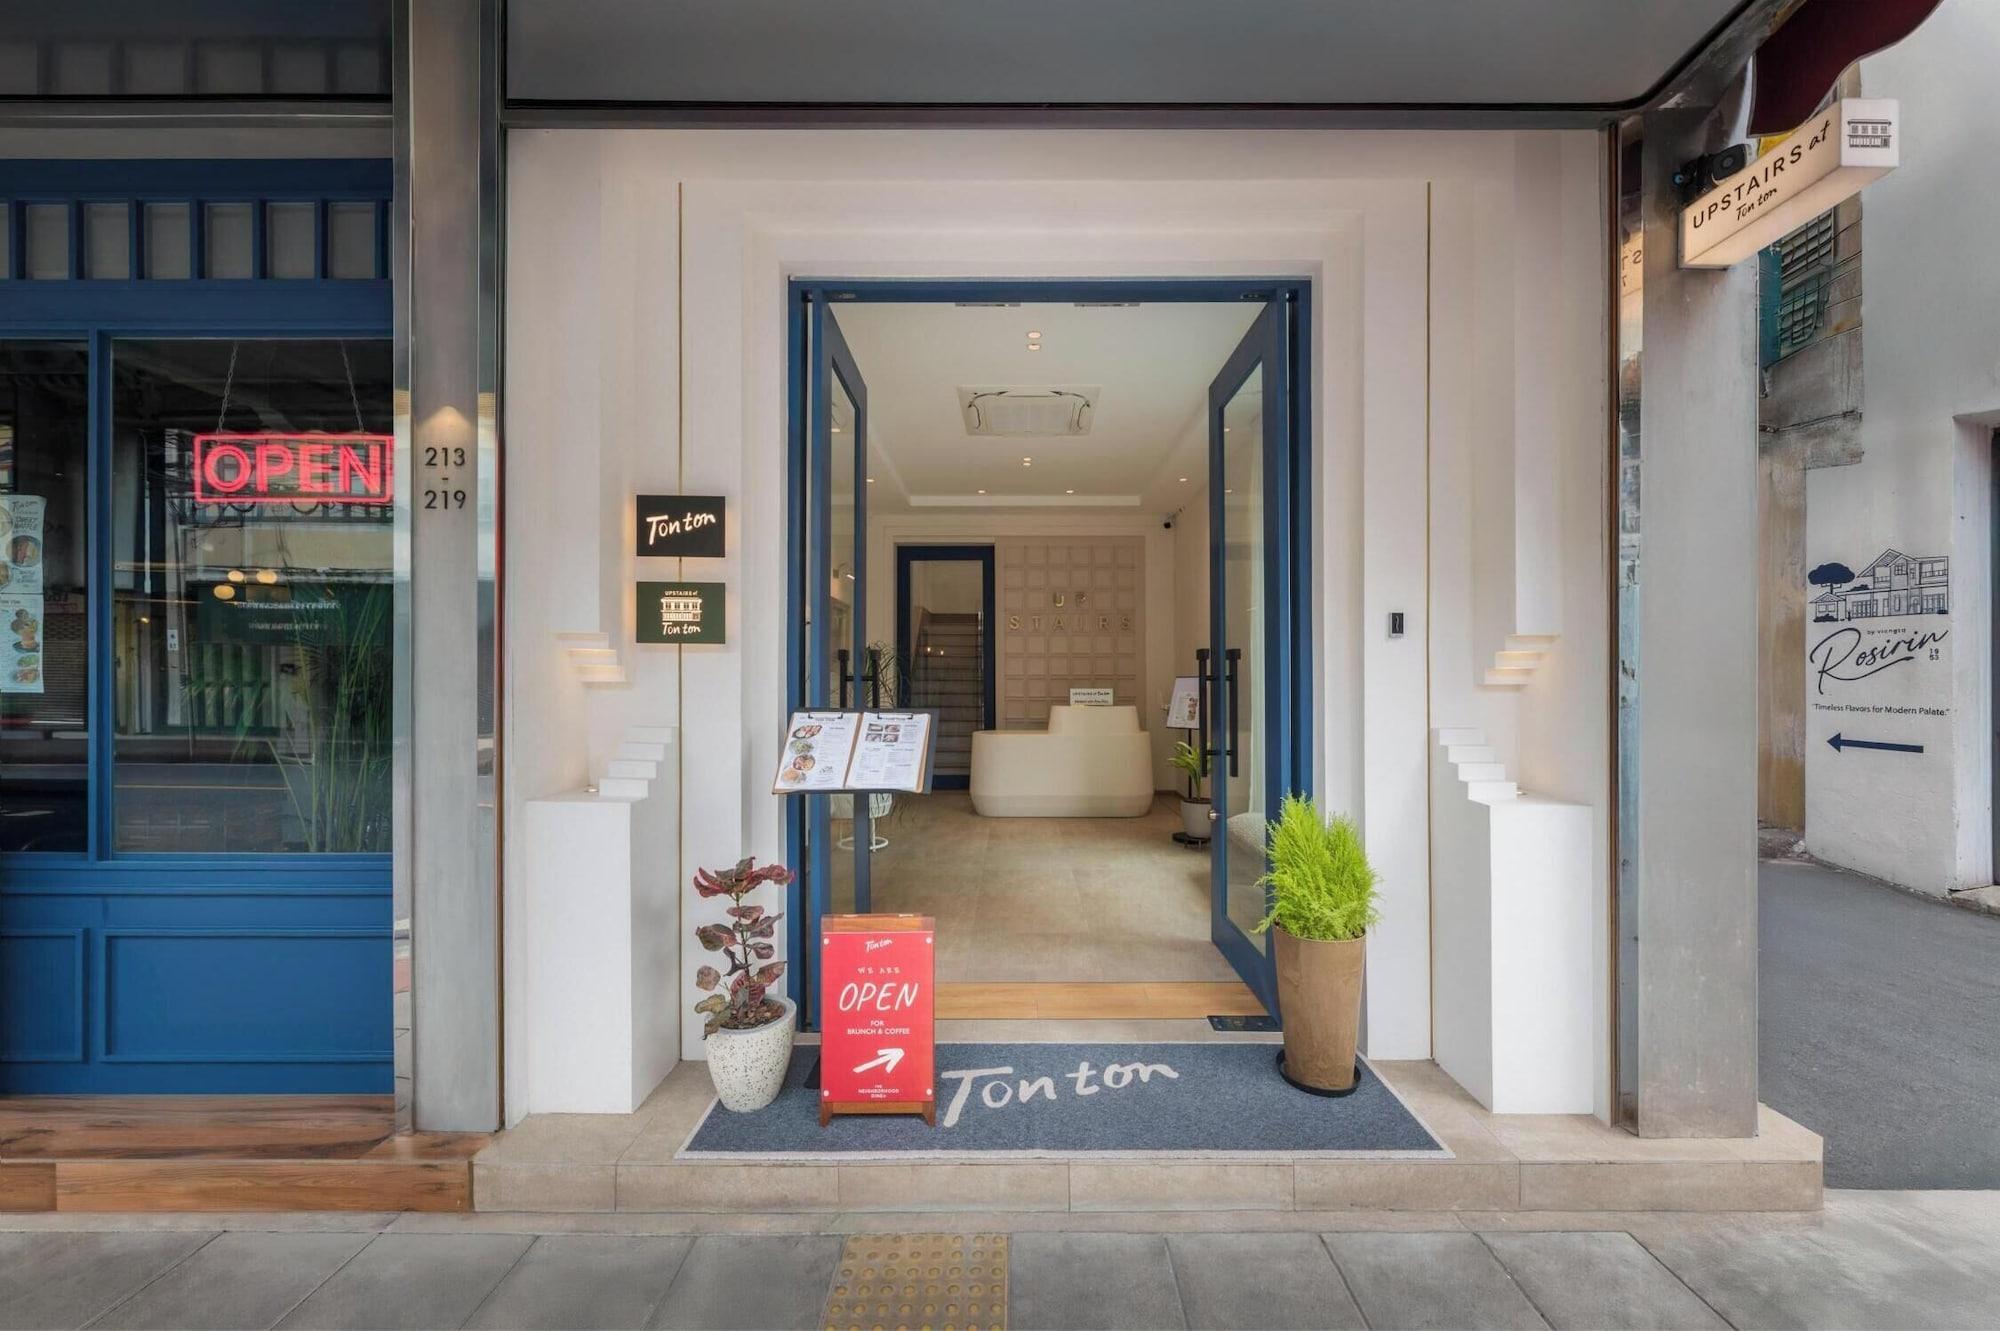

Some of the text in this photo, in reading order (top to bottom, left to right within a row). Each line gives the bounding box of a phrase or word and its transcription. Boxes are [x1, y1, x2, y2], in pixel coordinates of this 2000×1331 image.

[1693, 120, 1831, 229] UPSTAIRS at
[424, 448, 466, 467] 213
[204, 444, 381, 493] OPEN
[424, 490, 466, 509] 219
[1053, 591, 1087, 607] UP
[1009, 615, 1130, 631] STAIRS
[1810, 627, 1948, 695] Rosirin
[1845, 704, 1871, 713] Flavors
[1872, 705, 1883, 713] for
[1884, 706, 1917, 714] Modern
[858, 966, 900, 974] WE ARE
[839, 982, 919, 1012] OPEN
